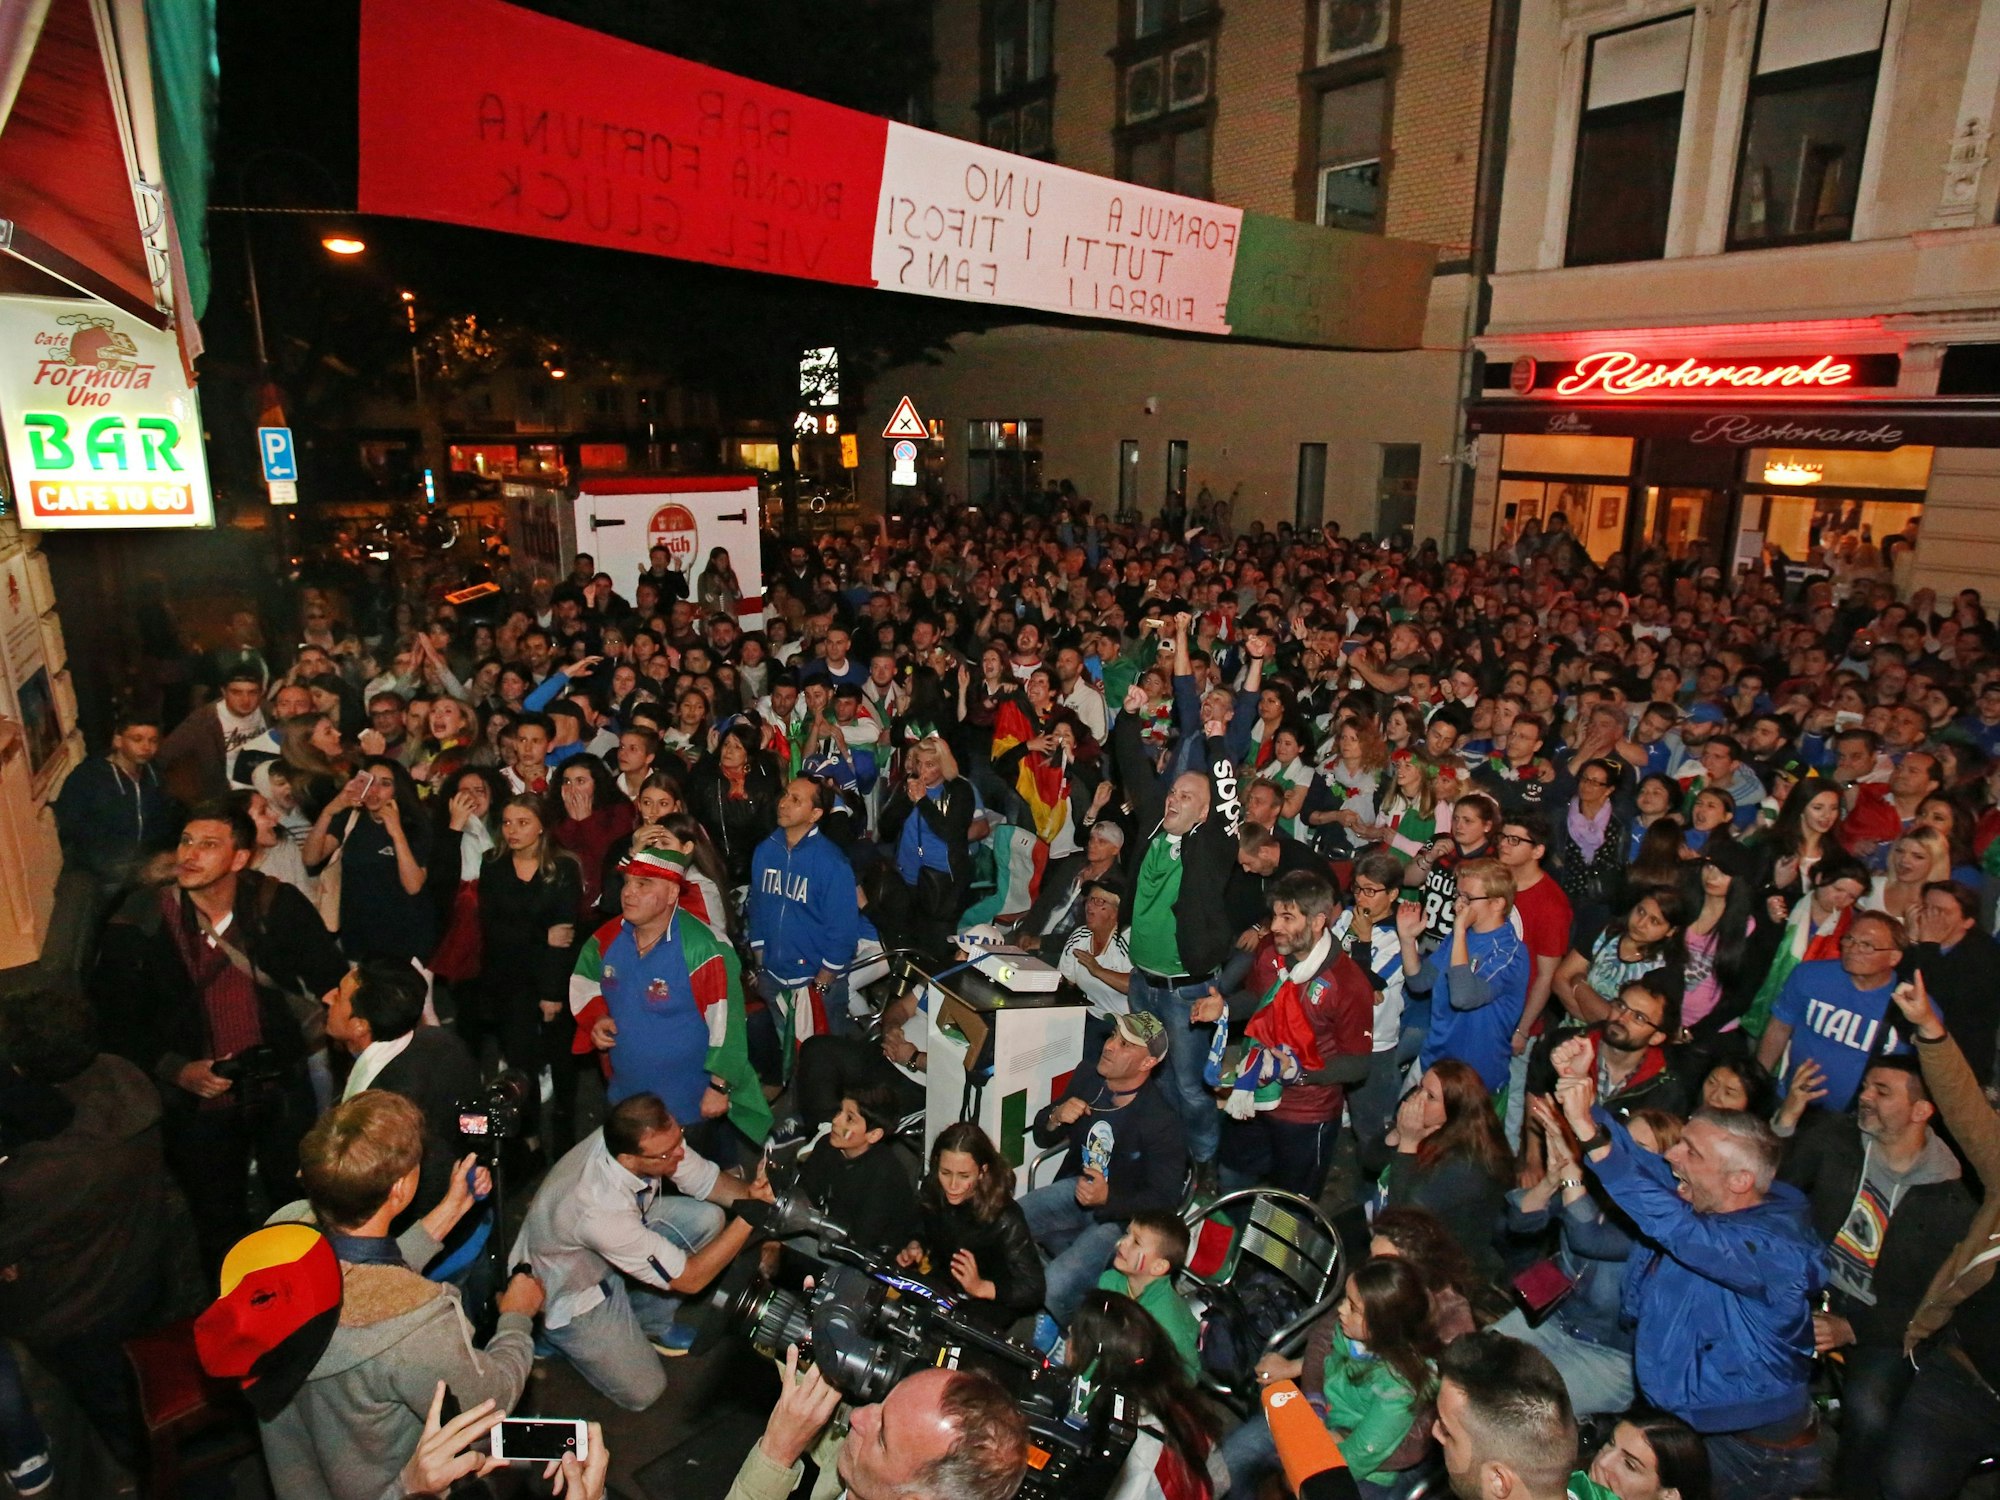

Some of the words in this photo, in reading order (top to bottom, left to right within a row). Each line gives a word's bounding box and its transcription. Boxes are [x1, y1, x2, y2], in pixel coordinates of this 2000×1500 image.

[34, 331, 70, 346] Cafe
[33, 359, 156, 389] Formula
[1556, 350, 1853, 396] Ristorante
[67, 385, 112, 407] Uno
[24, 413, 185, 472] BAR
[1690, 414, 1904, 444] Ristorante
[265, 433, 287, 464] P
[38, 485, 110, 511] CAFE
[112, 486, 148, 510] TO
[152, 485, 187, 511] GO
[762, 867, 808, 904] ITALIA
